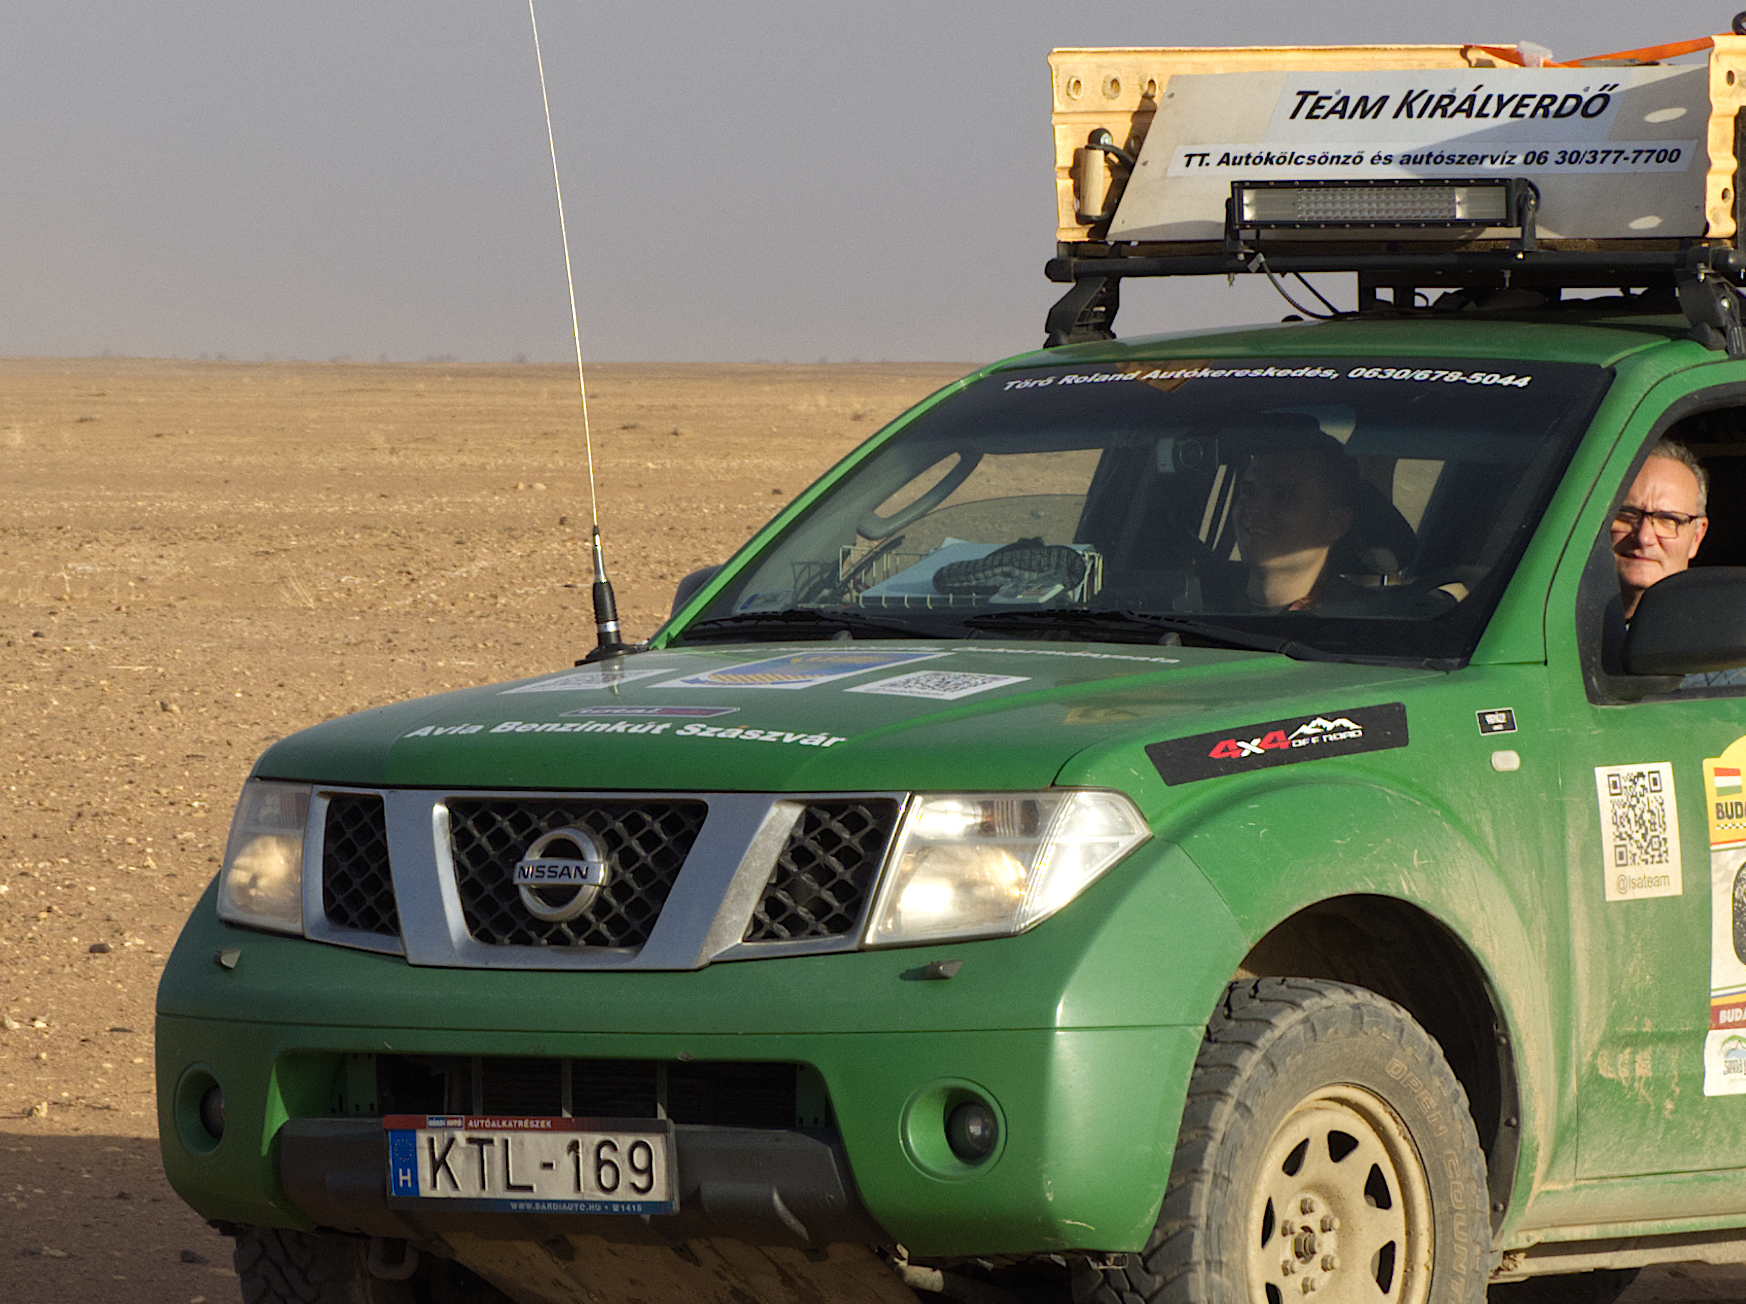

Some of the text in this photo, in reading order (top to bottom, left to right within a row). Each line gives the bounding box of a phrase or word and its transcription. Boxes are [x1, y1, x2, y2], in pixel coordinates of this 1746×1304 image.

[1184, 148, 1681, 168] TT. Autókölcsönző és autószervíz 06 30/377-7700
[1057, 370, 1143, 386] Roland
[1347, 366, 1533, 388] 0630/678-5044
[403, 720, 848, 747] Avia Benzinkút Szászvár
[1291, 729, 1363, 748] OFF ROAD
[518, 864, 589, 880] NISSAN
[1385, 1057, 1449, 1137] OPEN
[467, 1117, 552, 1129] AUTÓALKATRÉSZEK
[428, 1135, 655, 1194] KTL-169
[398, 1168, 412, 1188] H
